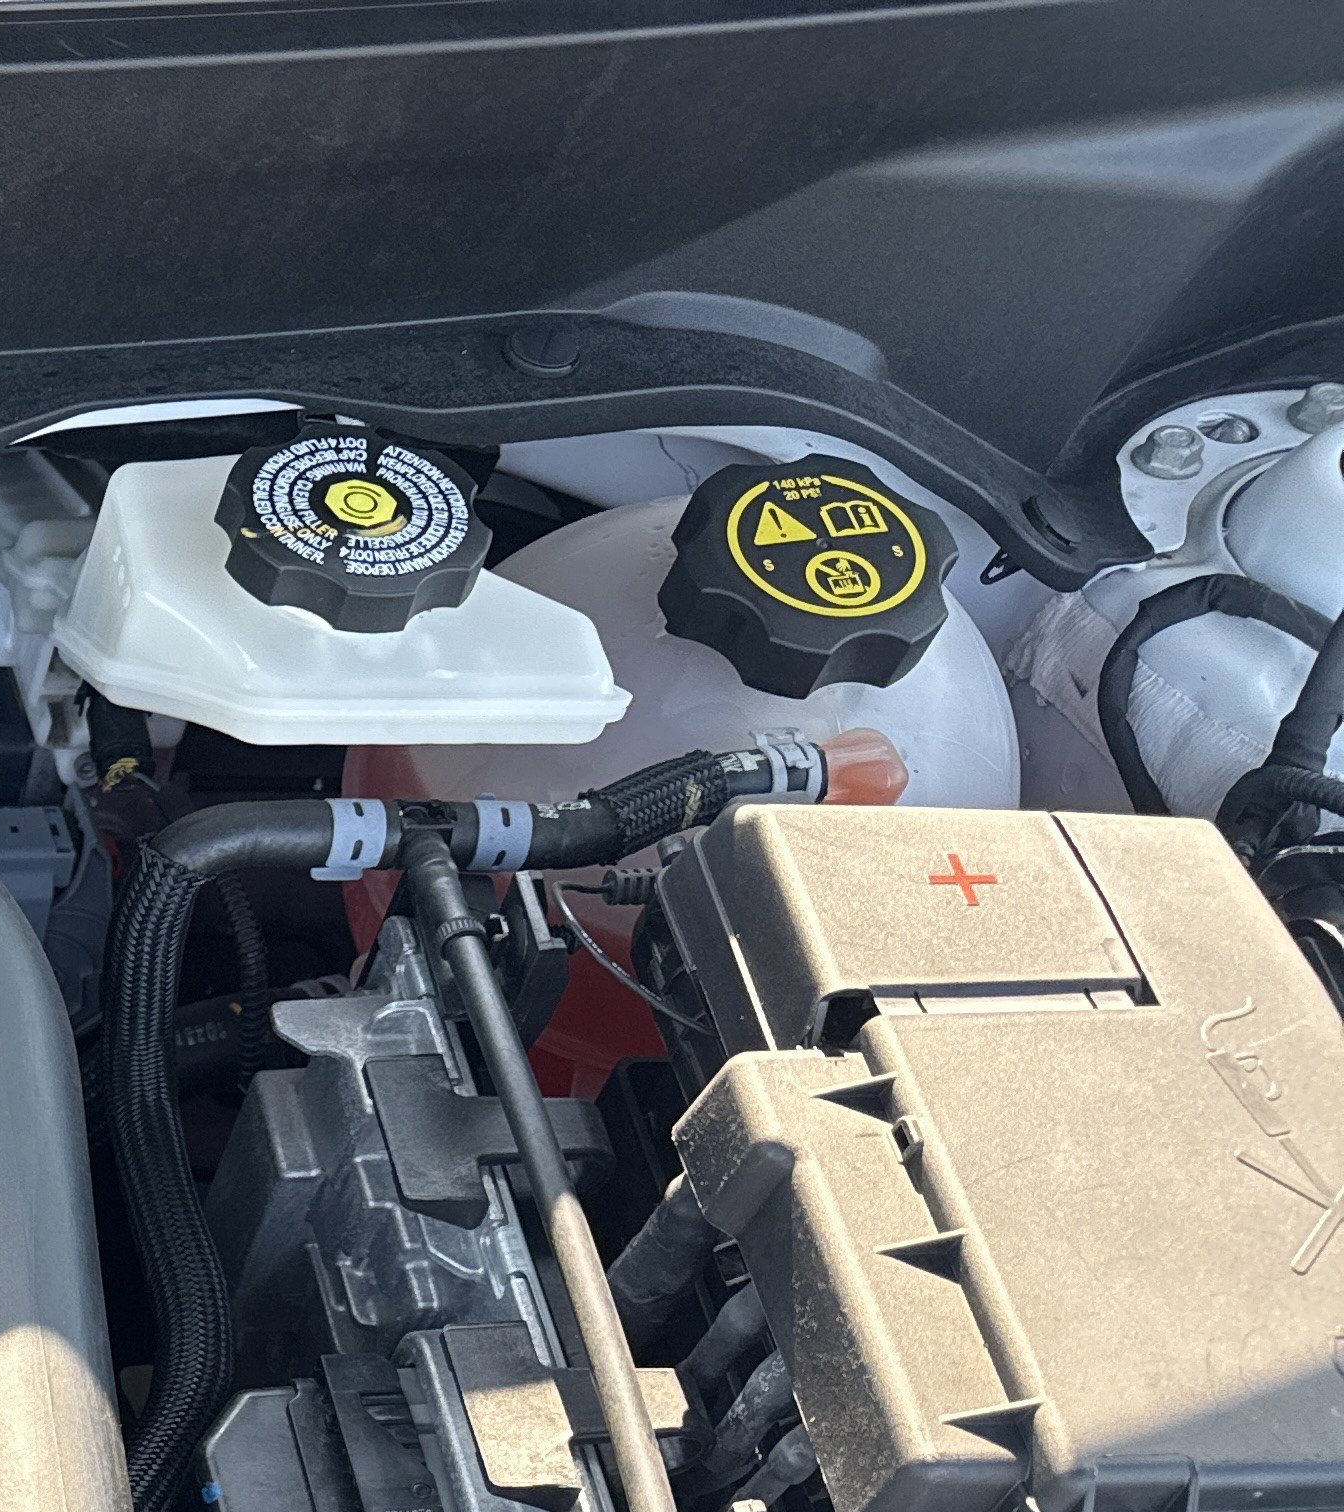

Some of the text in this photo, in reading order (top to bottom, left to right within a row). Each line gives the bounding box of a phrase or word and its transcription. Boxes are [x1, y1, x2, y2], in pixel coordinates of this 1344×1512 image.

[289, 450, 338, 472] BEFORE
[339, 450, 367, 461] CAP
[796, 476, 822, 488] kPa
[253, 437, 367, 565] DOT 4 FLUID FROM A SEALED CONTAINER.
[293, 462, 366, 540] WARNING: CLEAN FILLER
[428, 494, 448, 510] QUE
[436, 478, 469, 519] NETTOYER
[782, 490, 800, 501] 20
[279, 511, 304, 532] USE
[451, 519, 468, 531] LE
[297, 528, 332, 550] ONLY
[426, 529, 465, 563] BOUCHON
[339, 546, 350, 557] 4
[349, 548, 374, 562] DOT
[374, 547, 410, 561] FREIN
[404, 542, 425, 556] DE
[395, 555, 433, 574] AVANT
